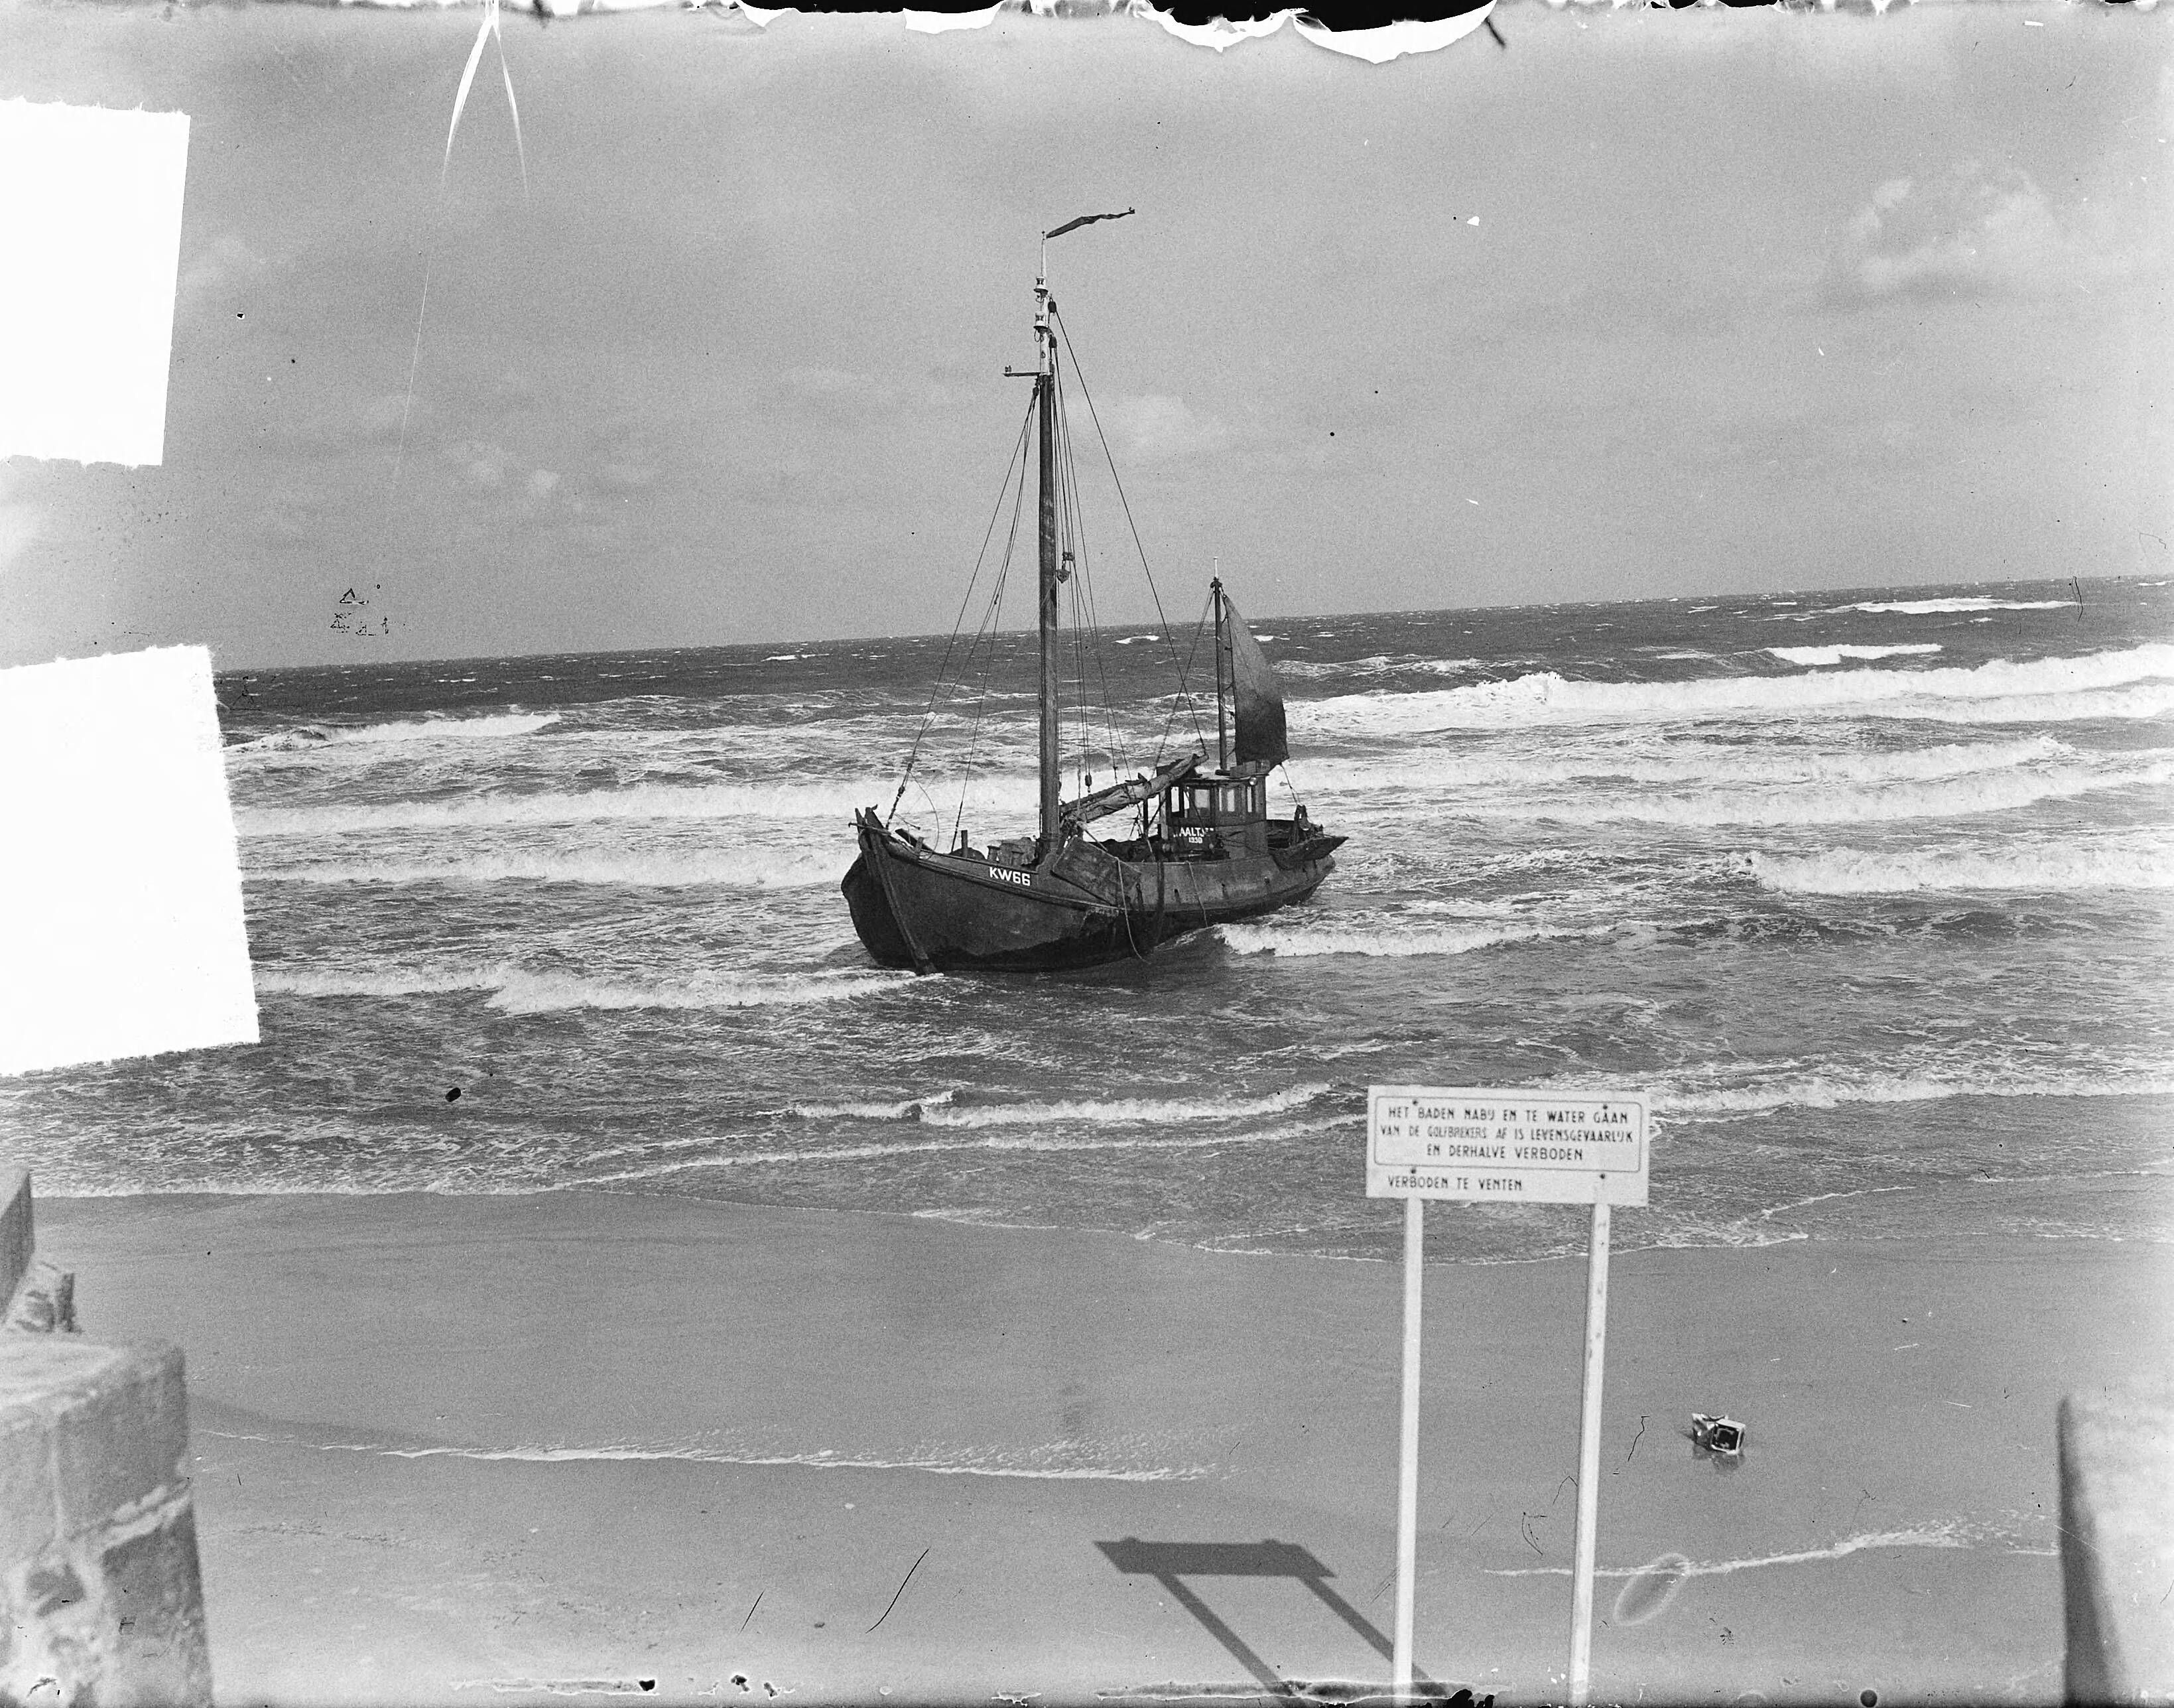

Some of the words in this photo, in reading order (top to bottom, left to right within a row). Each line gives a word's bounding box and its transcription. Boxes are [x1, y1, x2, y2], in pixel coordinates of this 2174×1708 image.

[990, 867, 1031, 886] KW66
[1388, 1106, 1409, 1119] HET
[1418, 1107, 1454, 1120] BADEN
[1503, 1109, 1517, 1122] EN
[1526, 1110, 1537, 1122] TE
[1547, 1110, 1585, 1123] WATER
[1593, 1111, 1628, 1124] GAAN
[1381, 1125, 1400, 1137] VAN
[1409, 1126, 1419, 1137] DE
[1496, 1127, 1507, 1140] AF
[1514, 1128, 1524, 1140] IS
[1531, 1128, 1633, 1142] LEVENSGEVAARLIJK
[1427, 1144, 1440, 1156] EN
[1449, 1144, 1505, 1159] DERHALVE
[1515, 1147, 1583, 1161] VERBODEN
[1388, 1175, 1448, 1189] VERBODEN
[1456, 1177, 1468, 1190] TE
[1478, 1178, 1523, 1191] VENTEN
